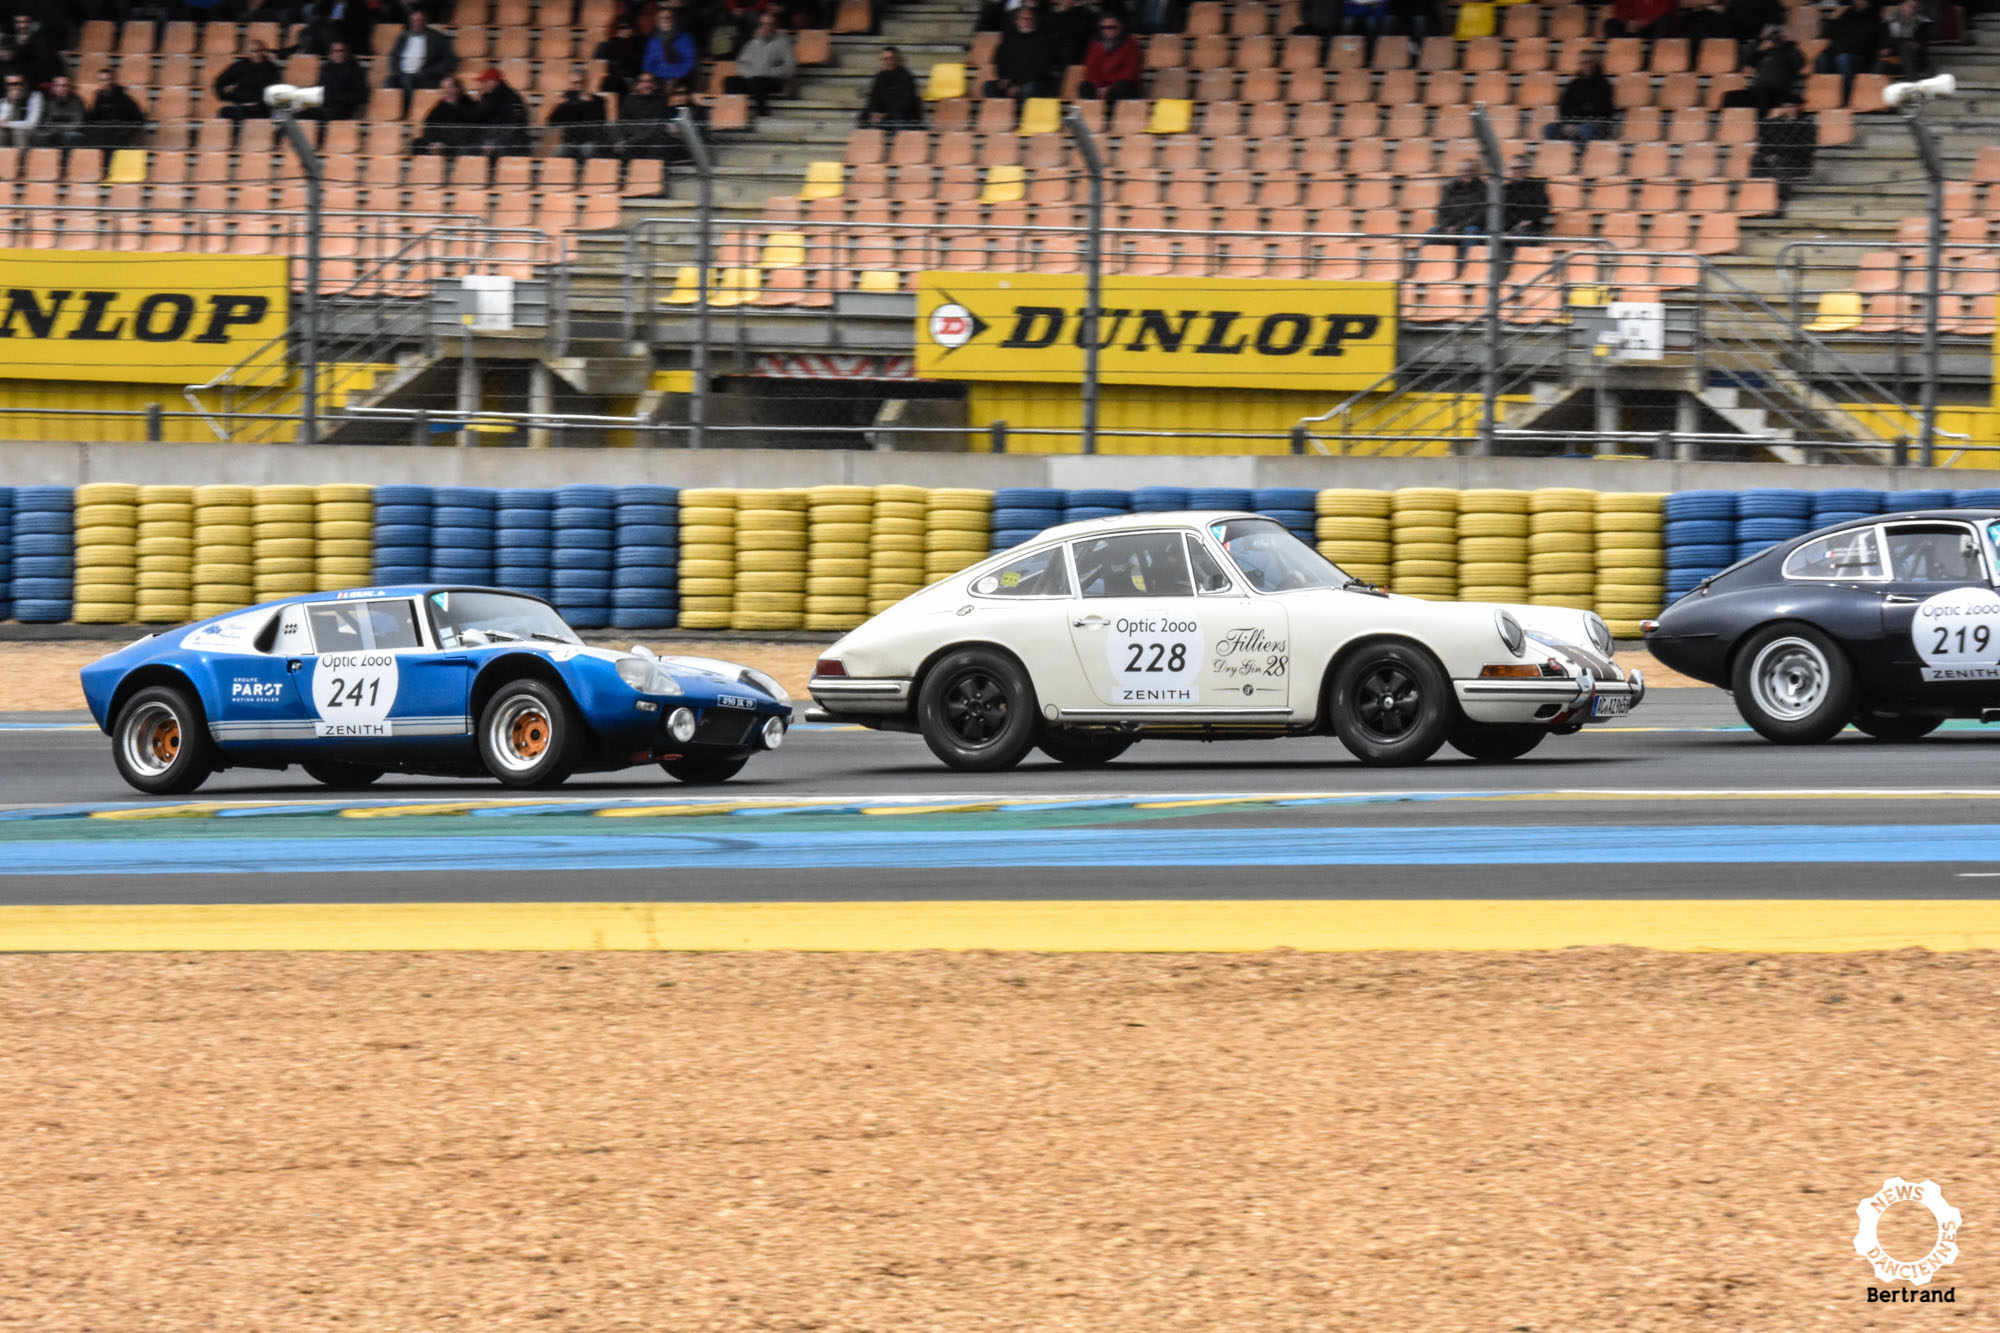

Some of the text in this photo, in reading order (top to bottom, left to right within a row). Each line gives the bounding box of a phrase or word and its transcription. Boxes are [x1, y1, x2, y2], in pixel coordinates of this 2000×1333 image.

[999, 306, 1380, 357] DUNLOP
[1923, 603, 2000, 620] Optic 2000
[1116, 618, 1197, 637] Optic 2000
[1216, 626, 1286, 657] Filliers
[1932, 625, 1990, 654] 219
[322, 654, 392, 672] Optic 2000
[1124, 643, 1187, 672] 228
[1213, 655, 1289, 678] Dry Gin 28
[1932, 669, 1999, 679] ZENITH
[327, 677, 380, 707] 241
[1123, 690, 1190, 700] ZENITH
[325, 725, 384, 735] ZENITH
